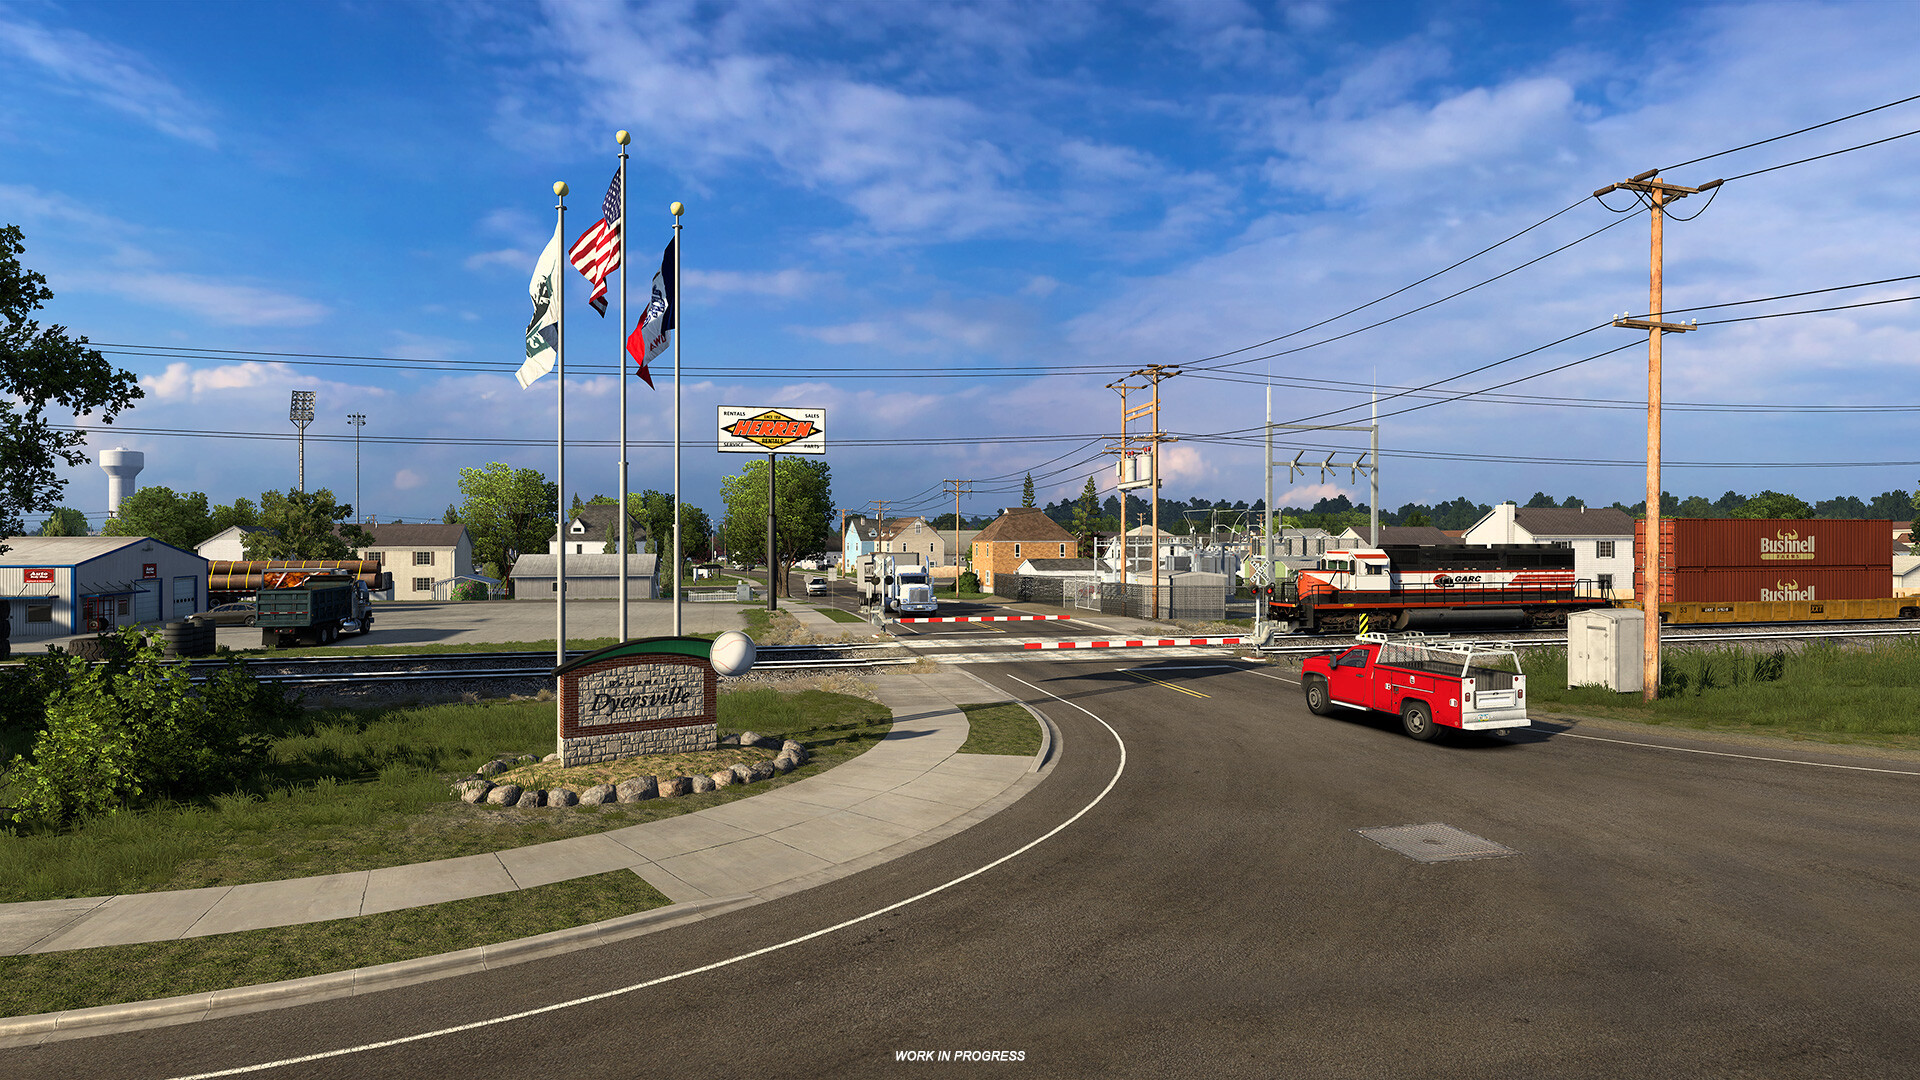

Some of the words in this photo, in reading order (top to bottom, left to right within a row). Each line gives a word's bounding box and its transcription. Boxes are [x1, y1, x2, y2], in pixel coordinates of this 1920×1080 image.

[732, 420, 813, 437] HERREN
[1760, 535, 1815, 553] Bushnell
[1760, 585, 1815, 602] Bushnell
[1679, 606, 1688, 614] 53
[609, 679, 658, 687] Welcome
[589, 686, 691, 716] Dyersville
